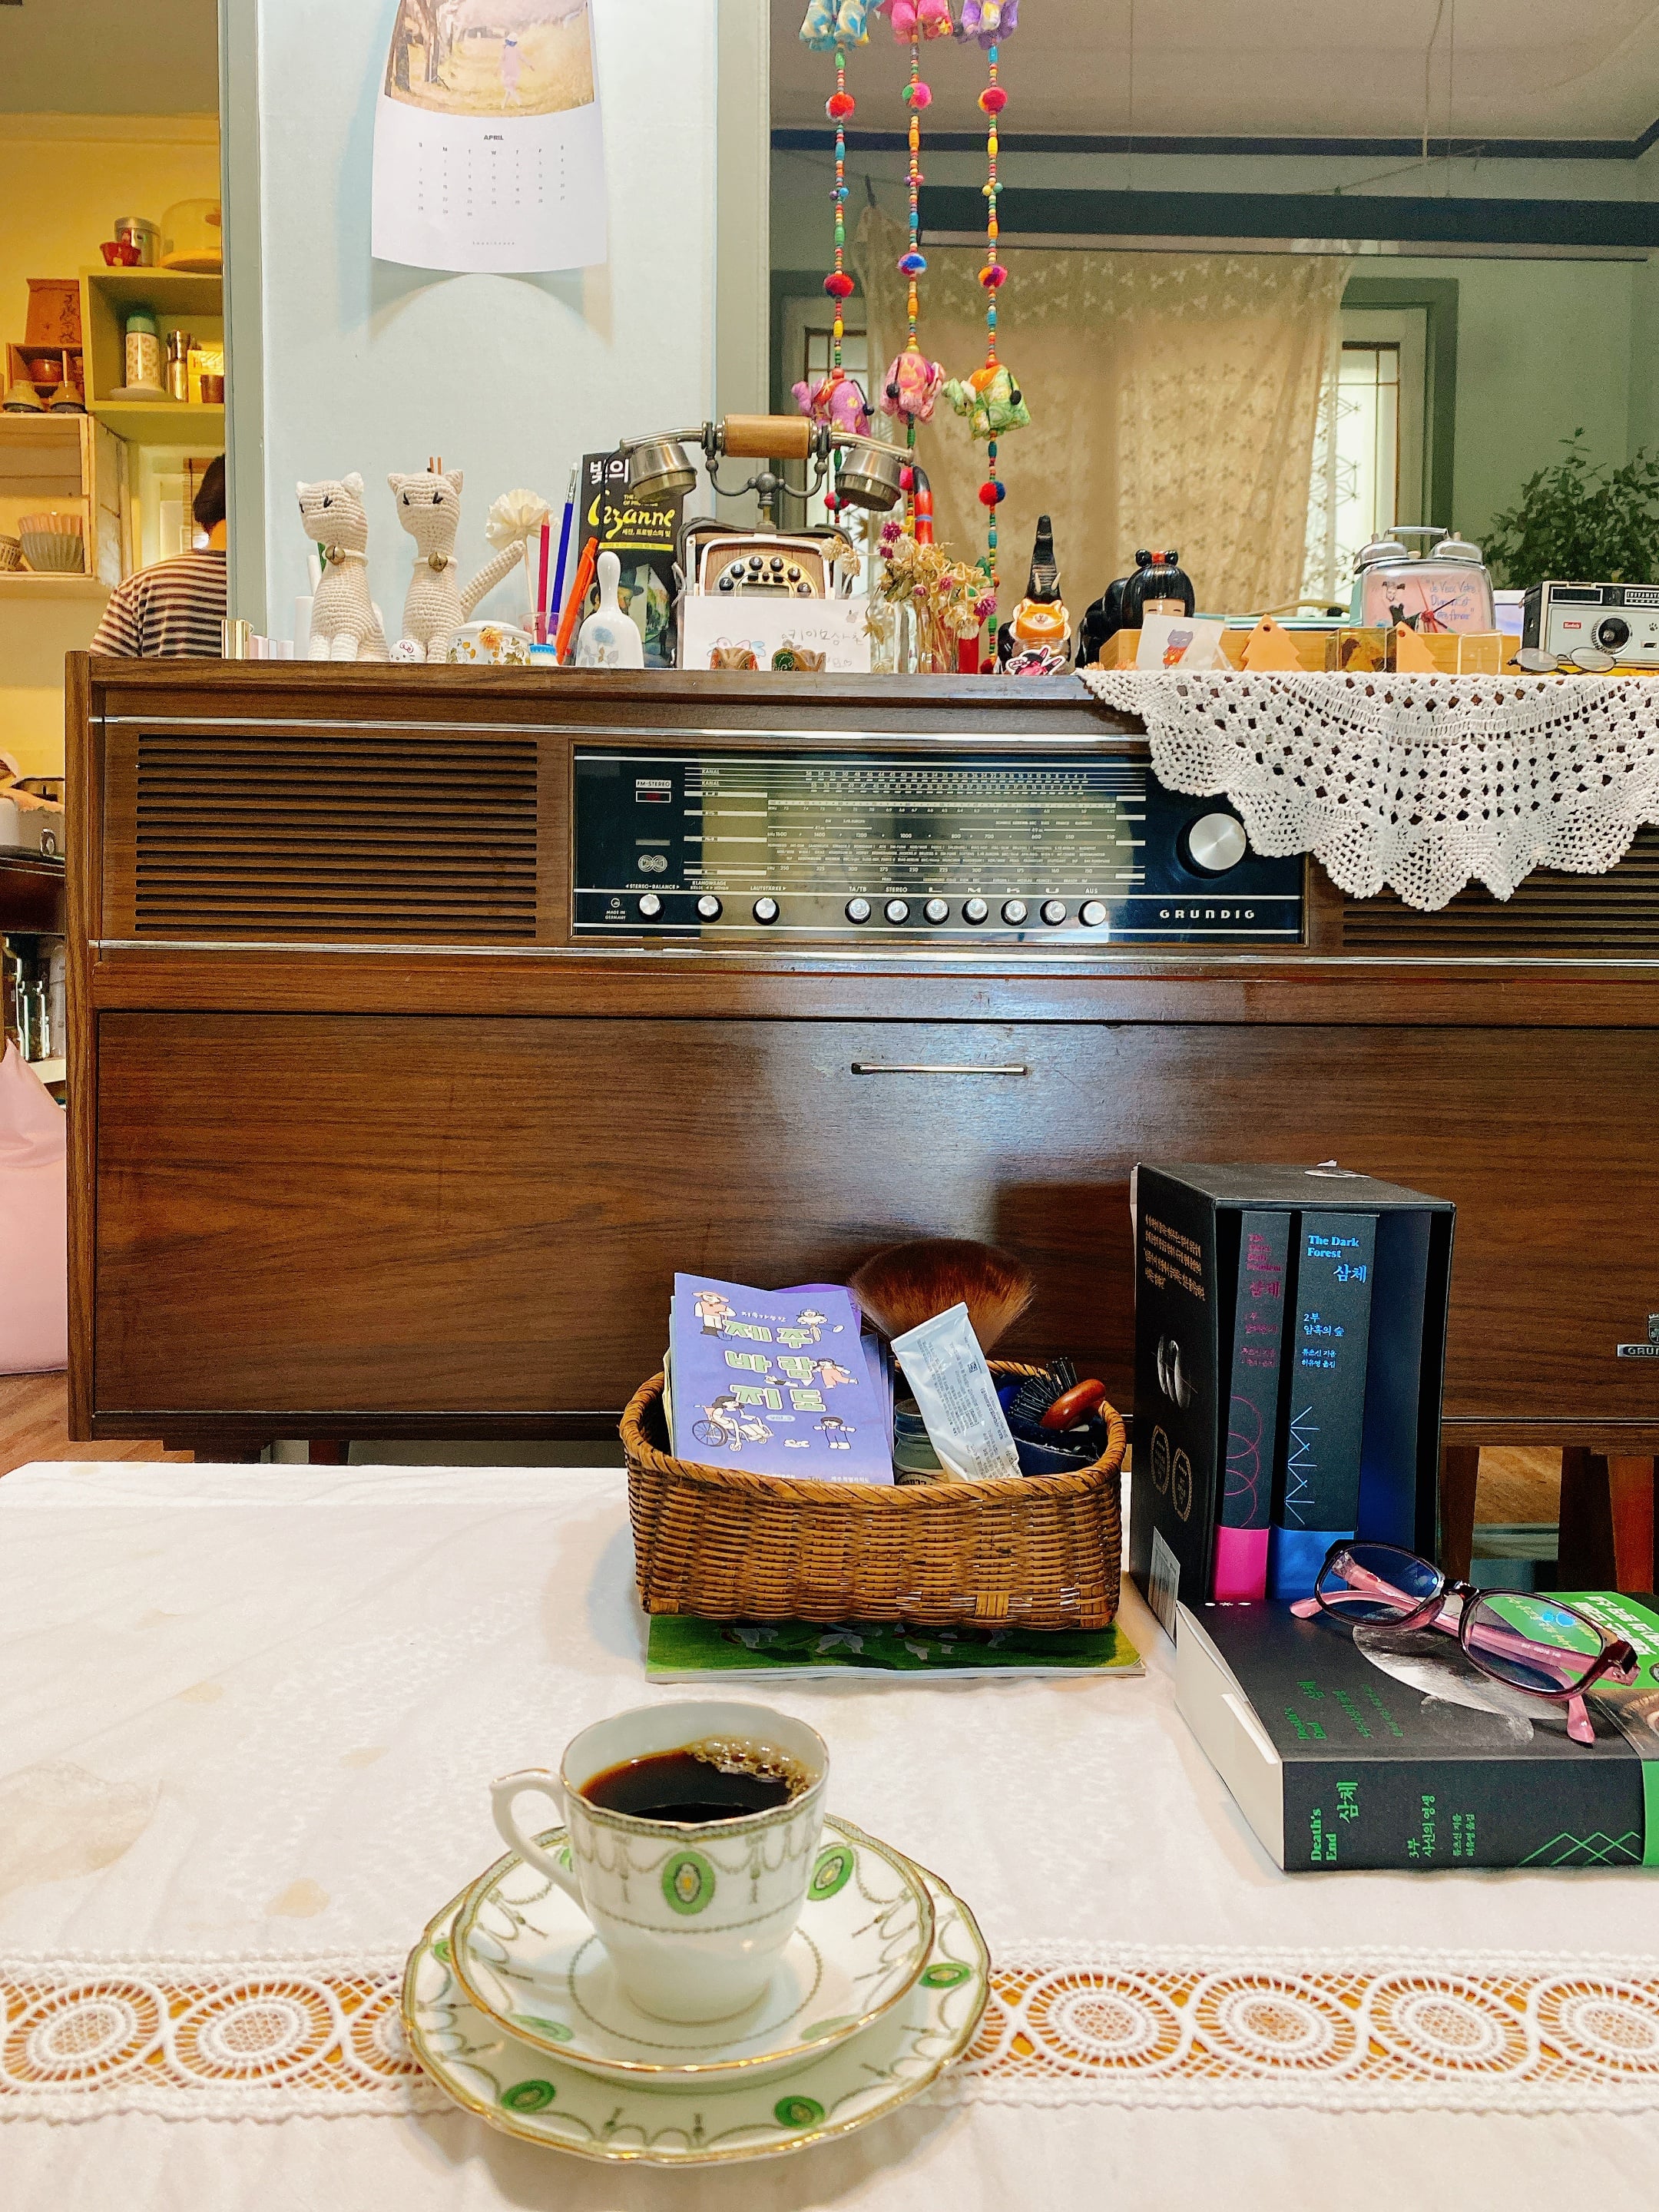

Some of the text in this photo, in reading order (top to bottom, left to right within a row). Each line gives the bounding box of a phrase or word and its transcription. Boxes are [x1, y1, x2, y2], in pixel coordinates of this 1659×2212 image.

[1159, 909, 1256, 919] GRUNDIG
[1307, 1247, 1342, 1258] Forest
[1308, 1235, 1359, 1247] The Dark
[1333, 1263, 1367, 1283] 삼체
[1303, 1312, 1320, 1323] 2부
[722, 1320, 814, 1349] 제주
[1303, 1325, 1345, 1337] 암흑의 숲
[724, 1350, 818, 1379] 바람
[729, 1385, 827, 1412] 지도
[1336, 1781, 1359, 1824] 삼체
[1310, 1808, 1322, 1861] Death's
[1421, 1795, 1436, 1858] 사신의 영생
[1326, 1833, 1337, 1861] End
[1407, 1838, 1421, 1859] 3부
